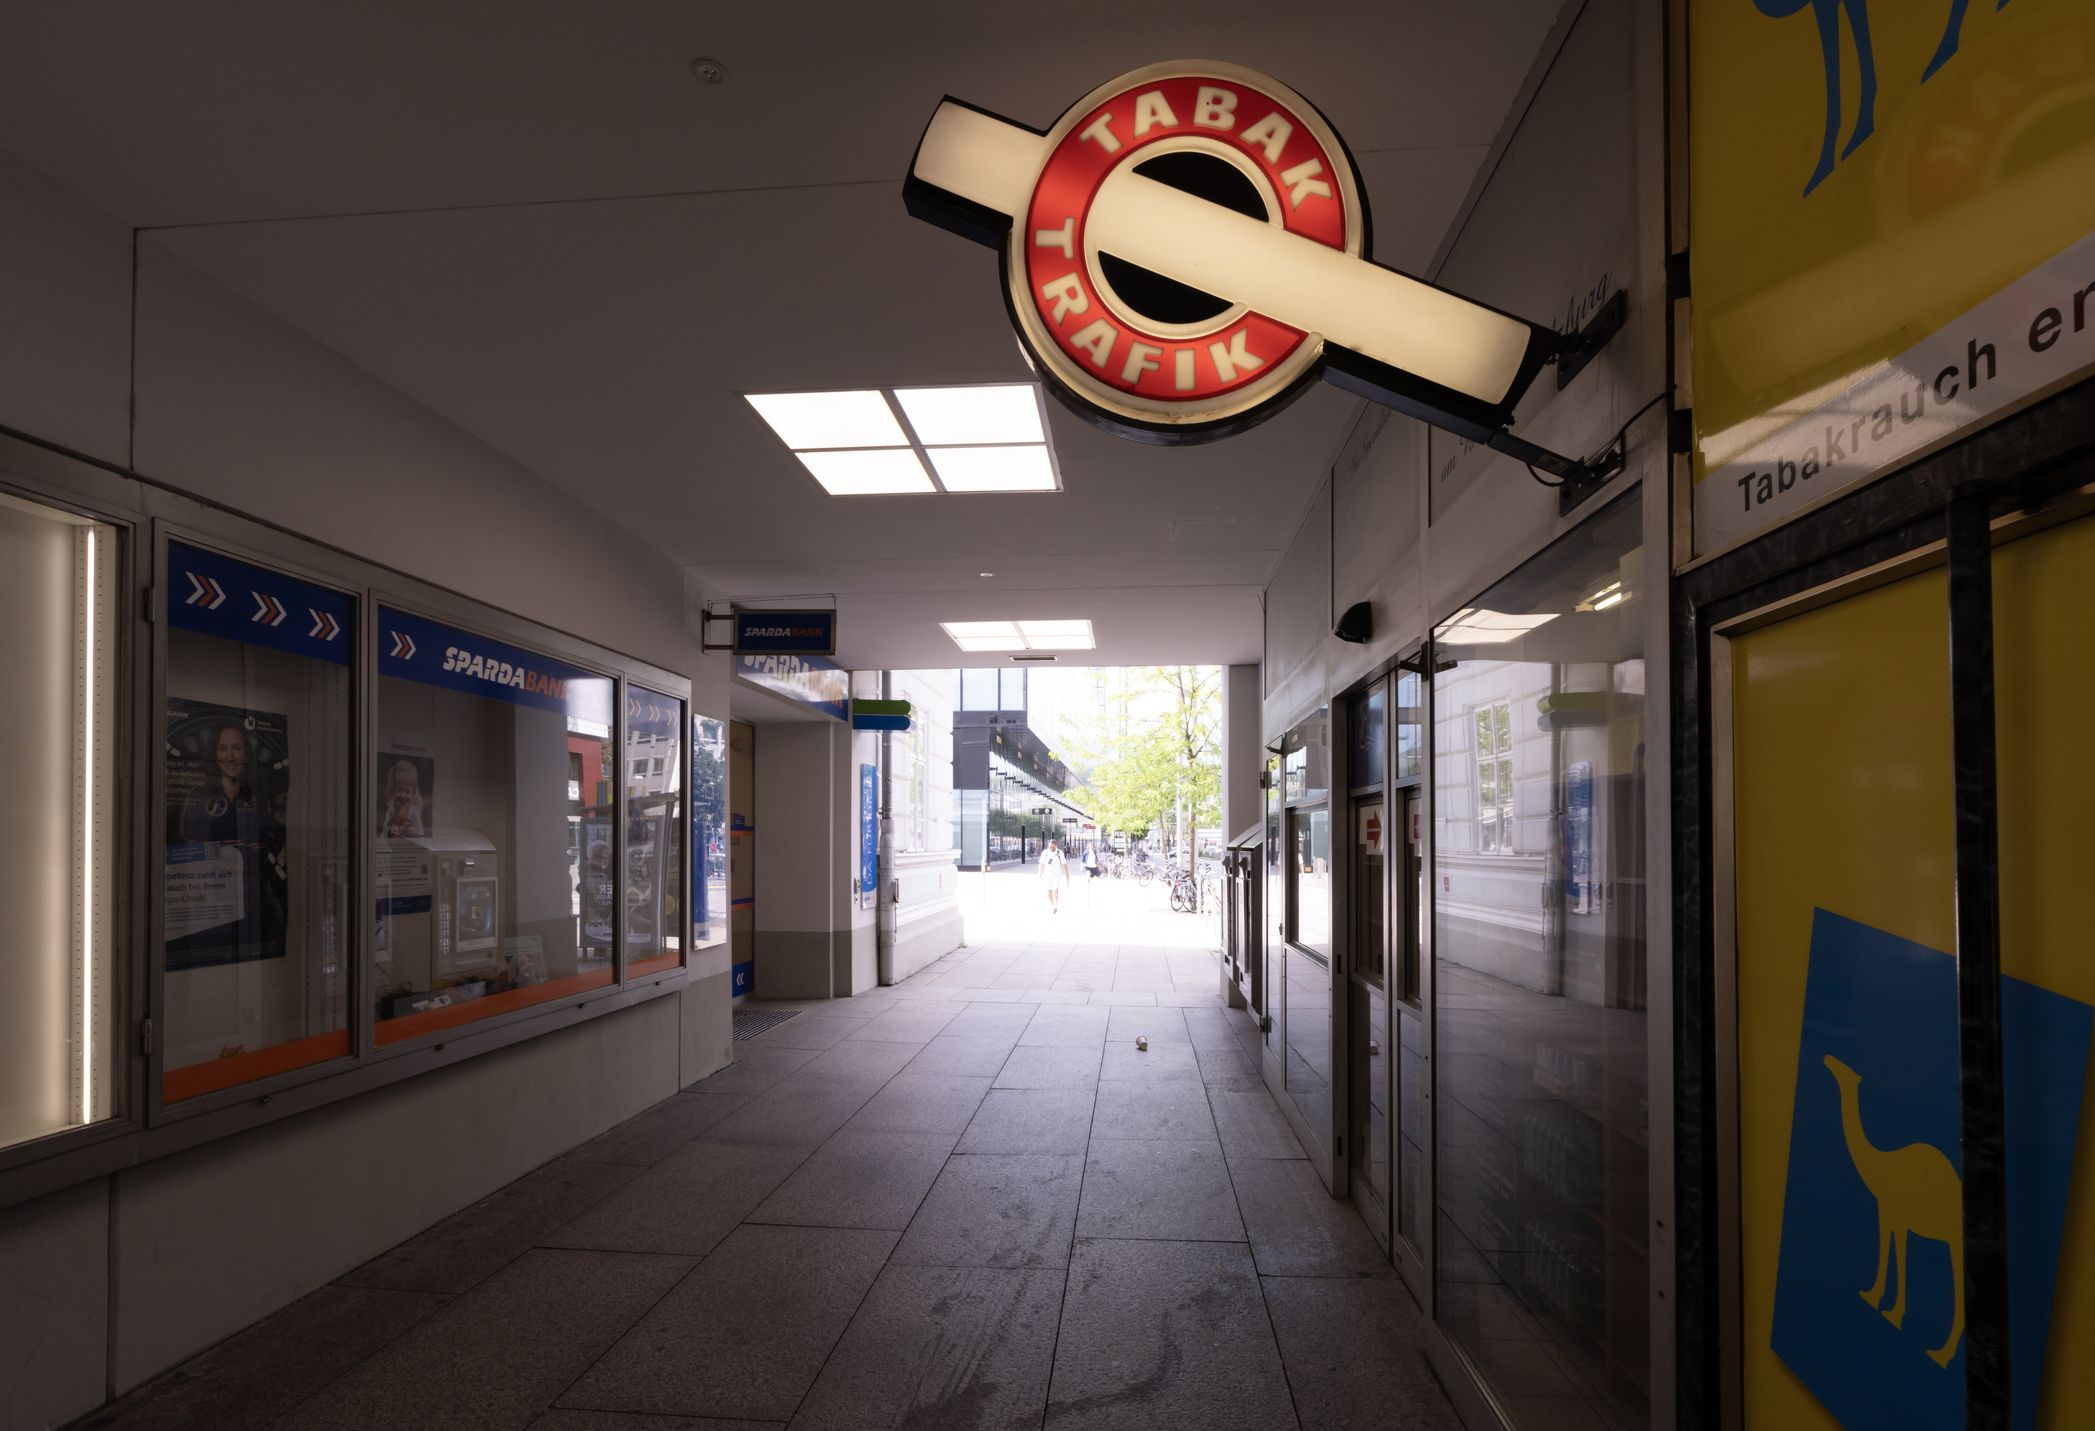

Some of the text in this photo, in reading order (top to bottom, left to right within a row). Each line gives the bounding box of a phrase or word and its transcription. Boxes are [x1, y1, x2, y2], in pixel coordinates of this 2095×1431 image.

[1080, 86, 1331, 212] TABAK
[1036, 217, 1265, 391] TRAFIK
[1738, 338, 1997, 513] Tabakrauch
[744, 627, 824, 638] SPARDABANK
